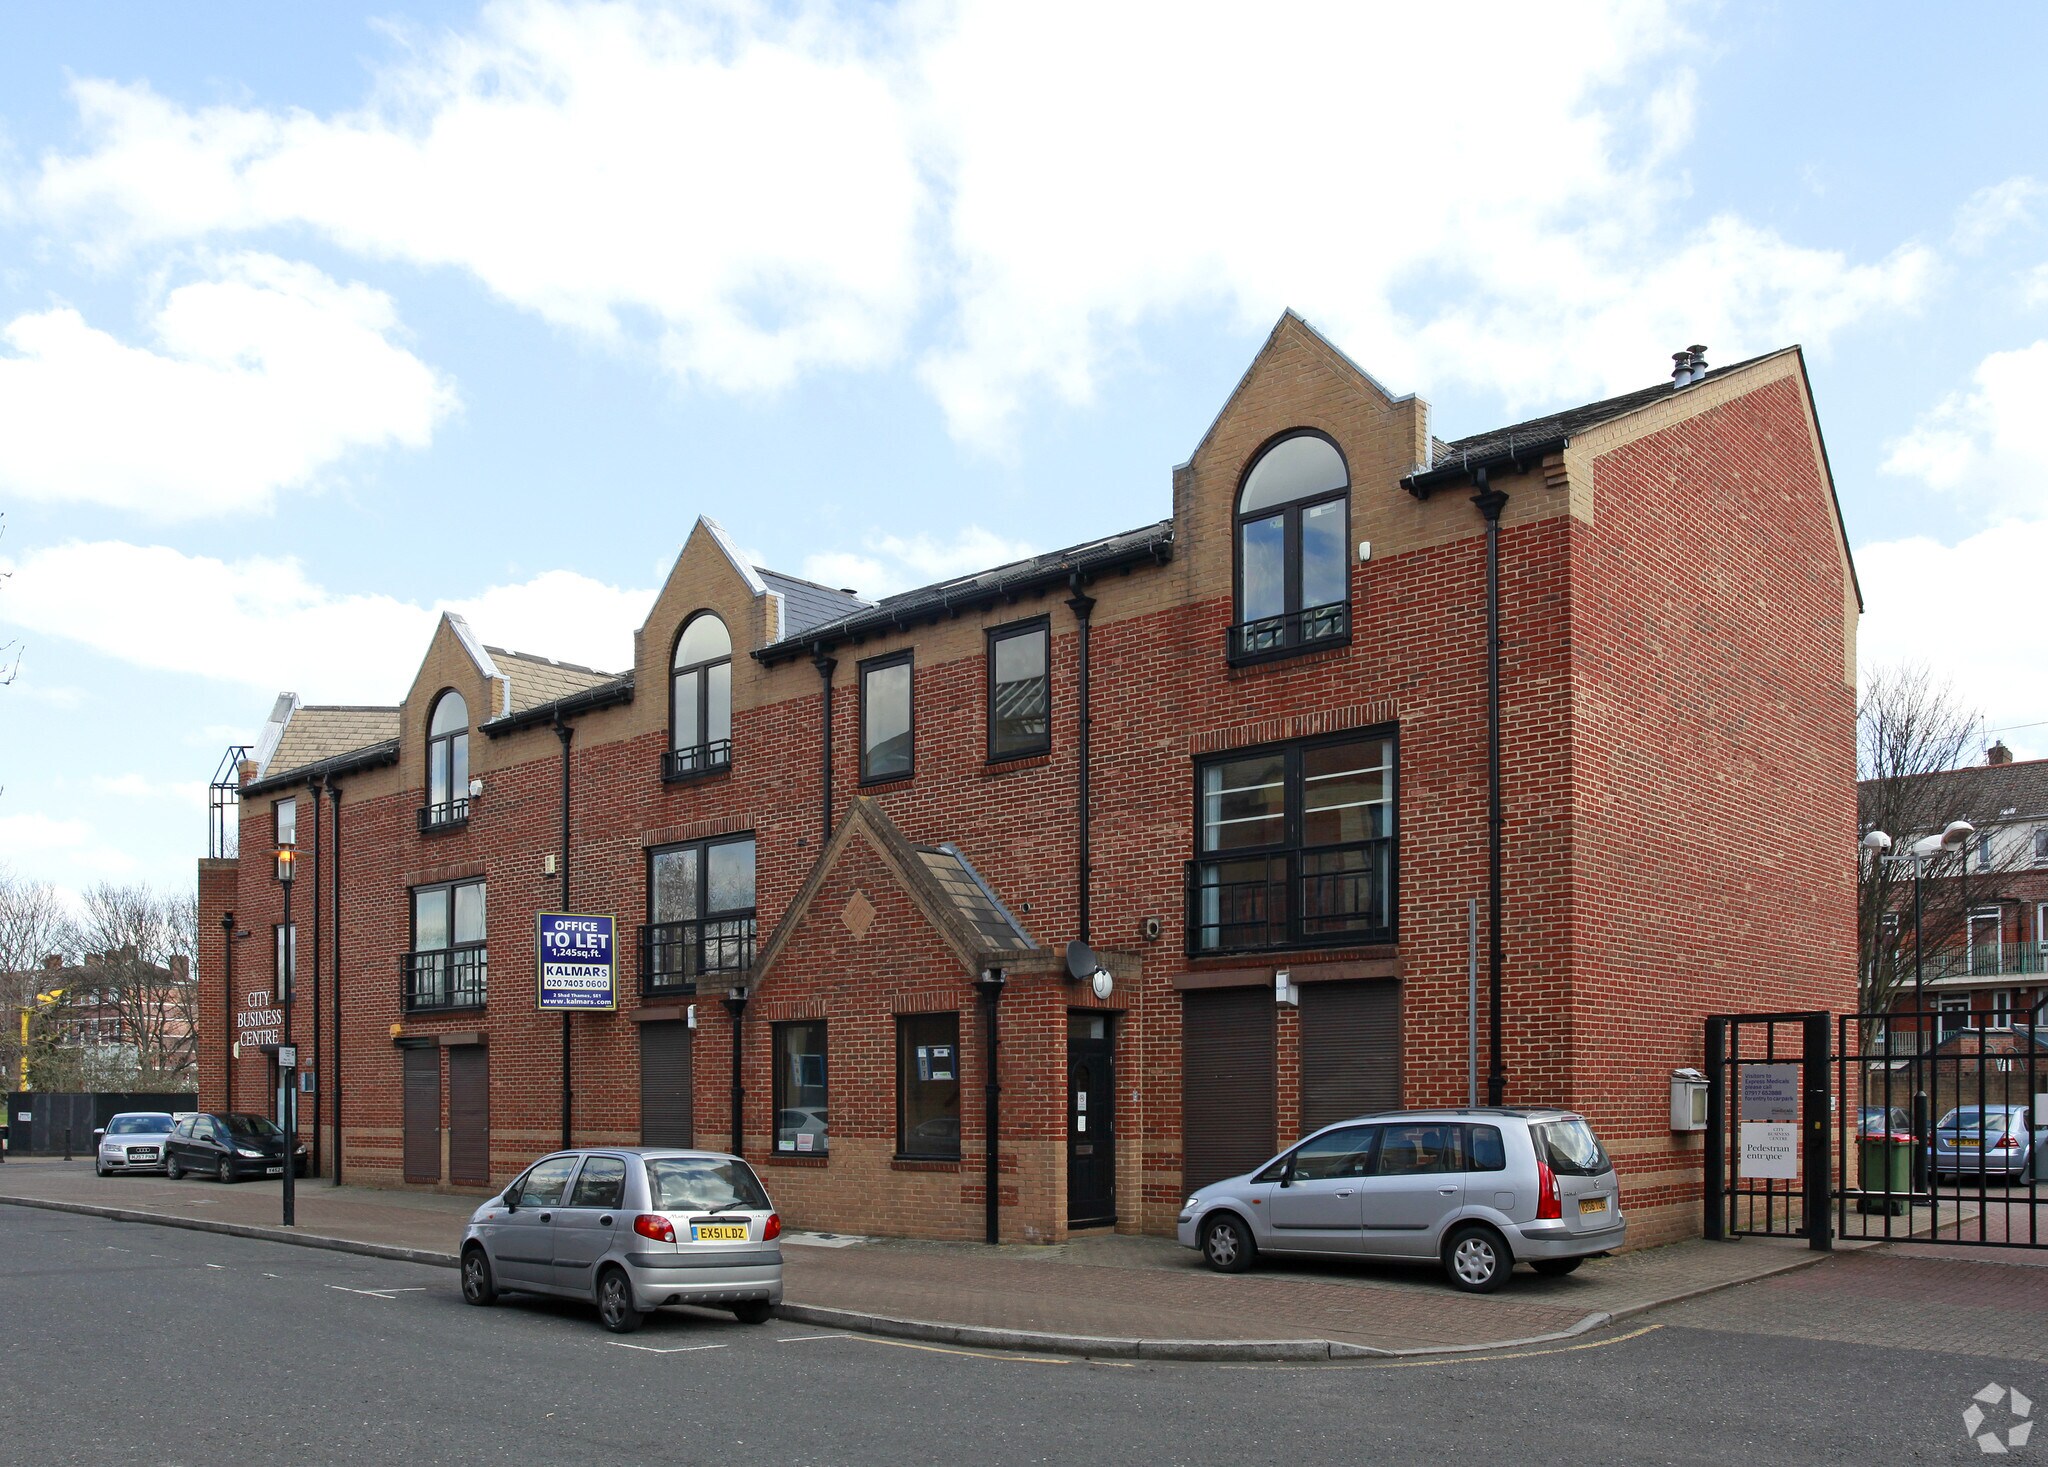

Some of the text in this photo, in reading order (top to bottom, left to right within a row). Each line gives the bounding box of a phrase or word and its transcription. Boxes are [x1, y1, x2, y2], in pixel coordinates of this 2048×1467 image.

[555, 921, 597, 932] OFFICE
[543, 932, 609, 949] TO LET
[552, 948, 601, 959] 1,245sq.ft.
[546, 979, 608, 988] 020 7403 0600
[248, 991, 270, 1007] CITY
[237, 1009, 282, 1028] BUSINESS
[240, 1029, 280, 1047] CENTRE
[1746, 1143, 1790, 1153] Pedestrian
[1746, 1153, 1783, 1161] entrance
[701, 1228, 744, 1239] EX51 LDZ
